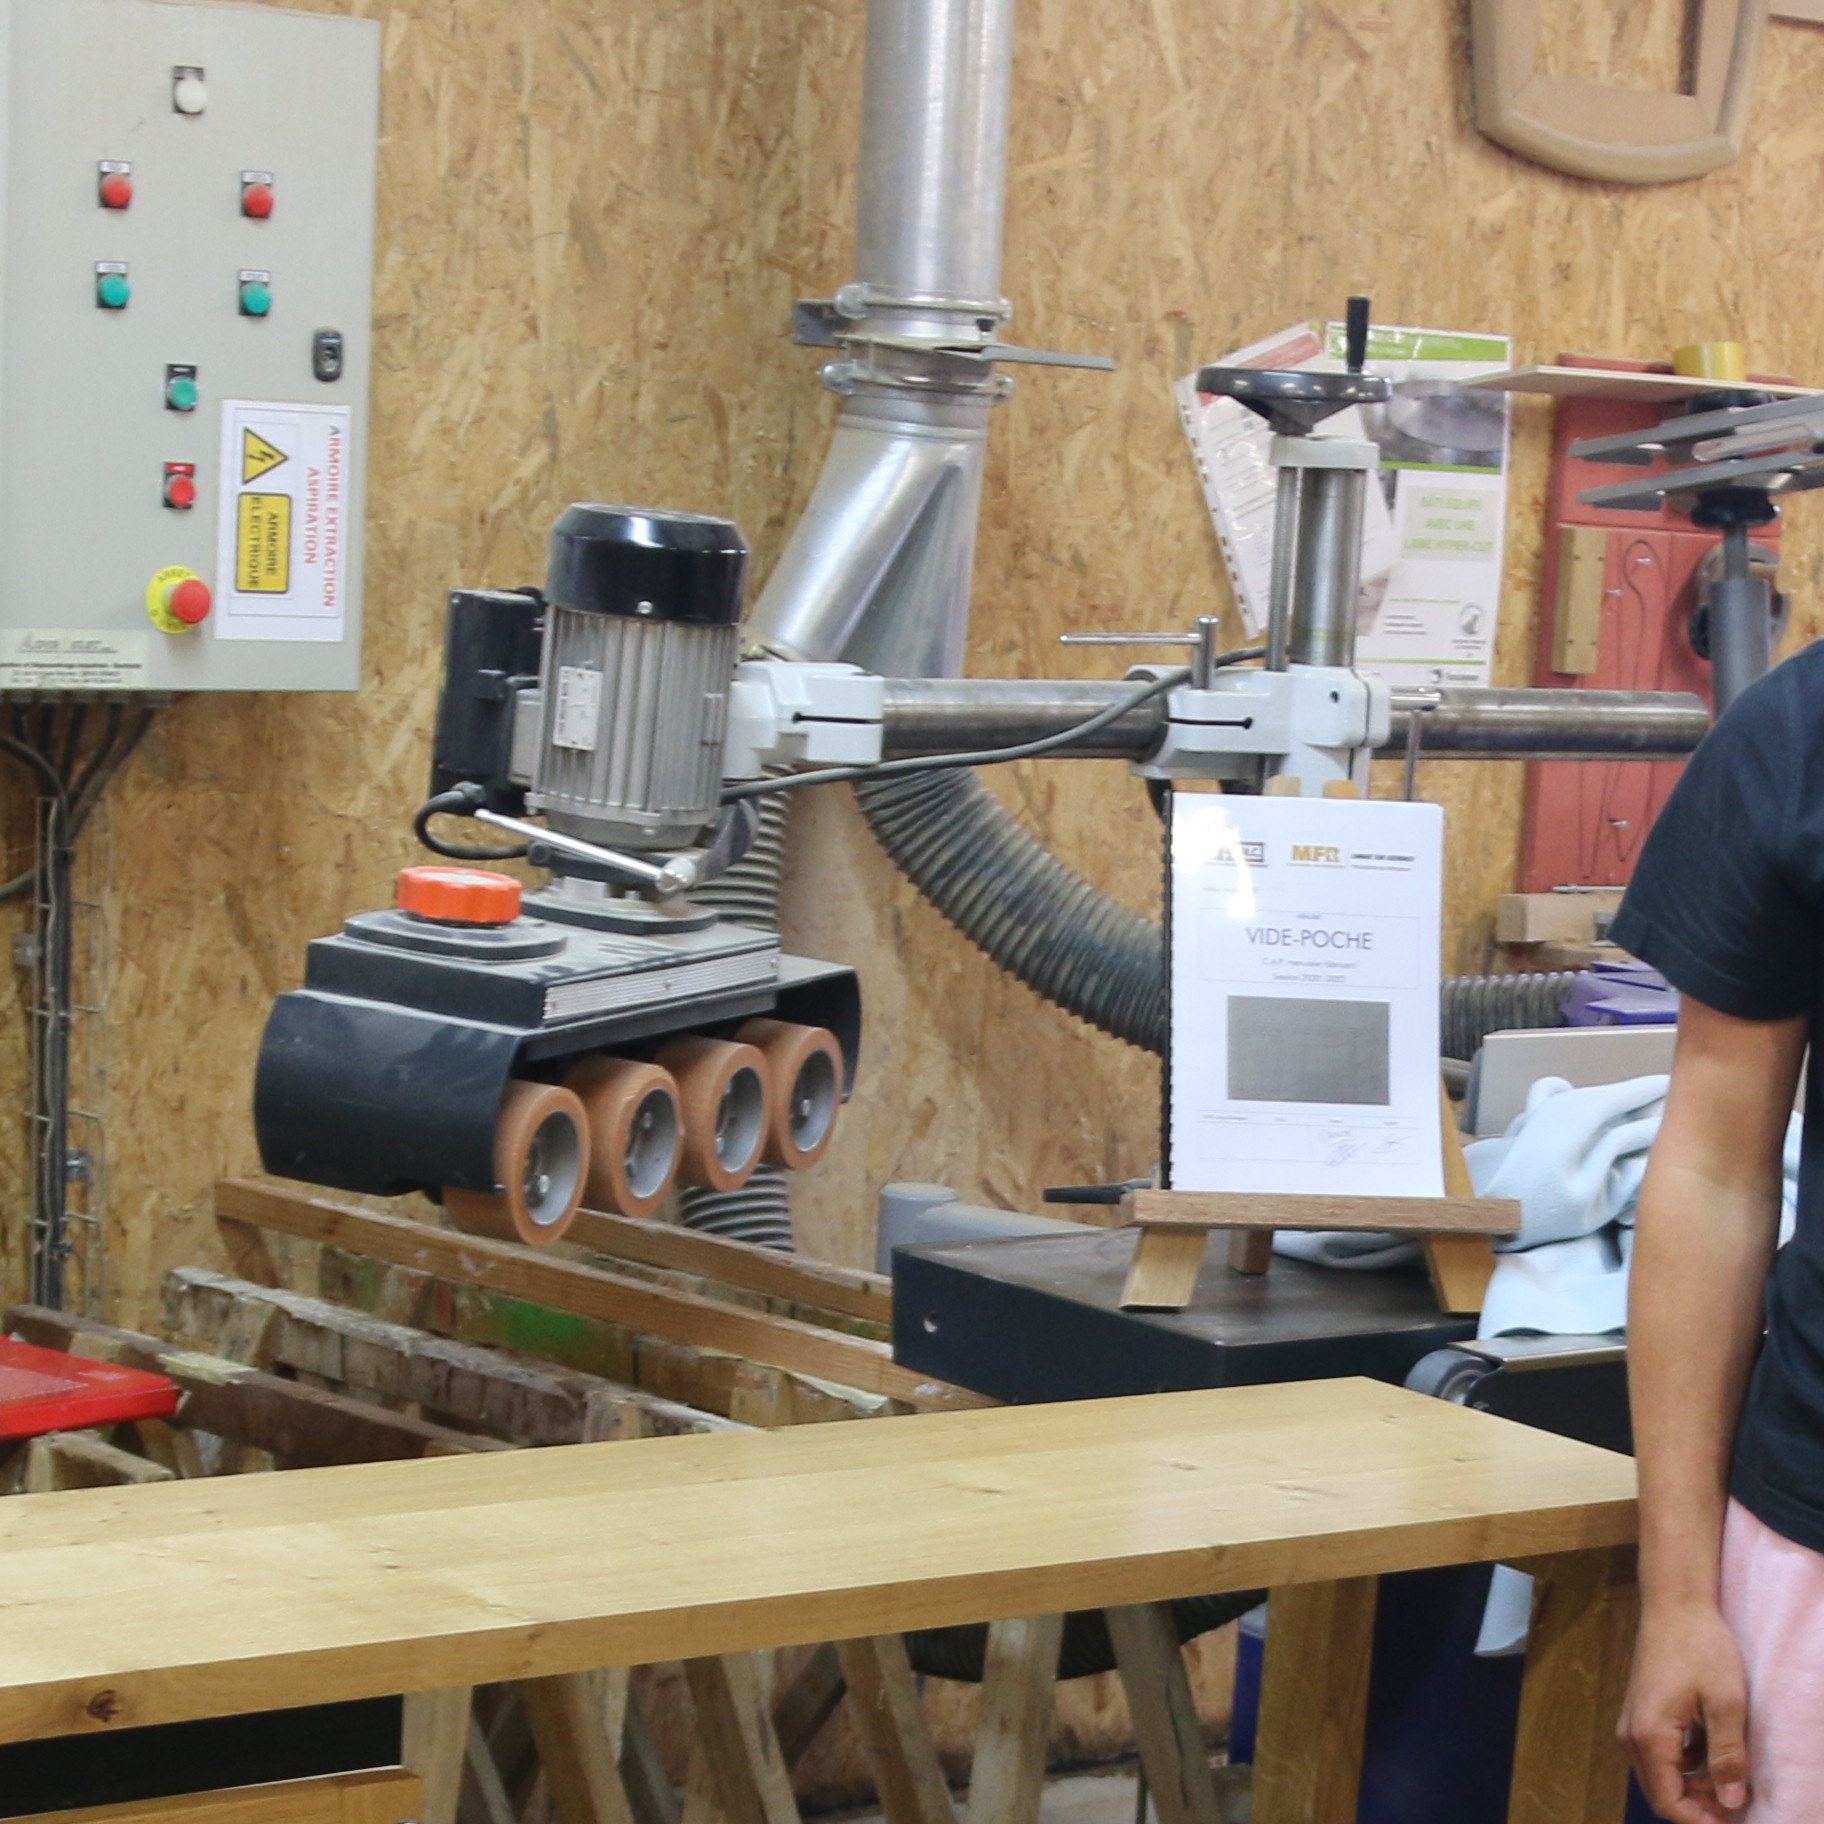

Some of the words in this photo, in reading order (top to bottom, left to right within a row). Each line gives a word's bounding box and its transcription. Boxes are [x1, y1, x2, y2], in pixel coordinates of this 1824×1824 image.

[325, 425, 341, 501] ARMOIRE
[248, 496, 262, 588] ELECTRIQUE
[266, 512, 280, 576] ARMOIRE
[303, 466, 321, 564] ASPIRATION
[322, 506, 339, 607] EXTRACTION
[1291, 845, 1341, 863] MFR
[1245, 927, 1374, 950] VIDE-POCHE
